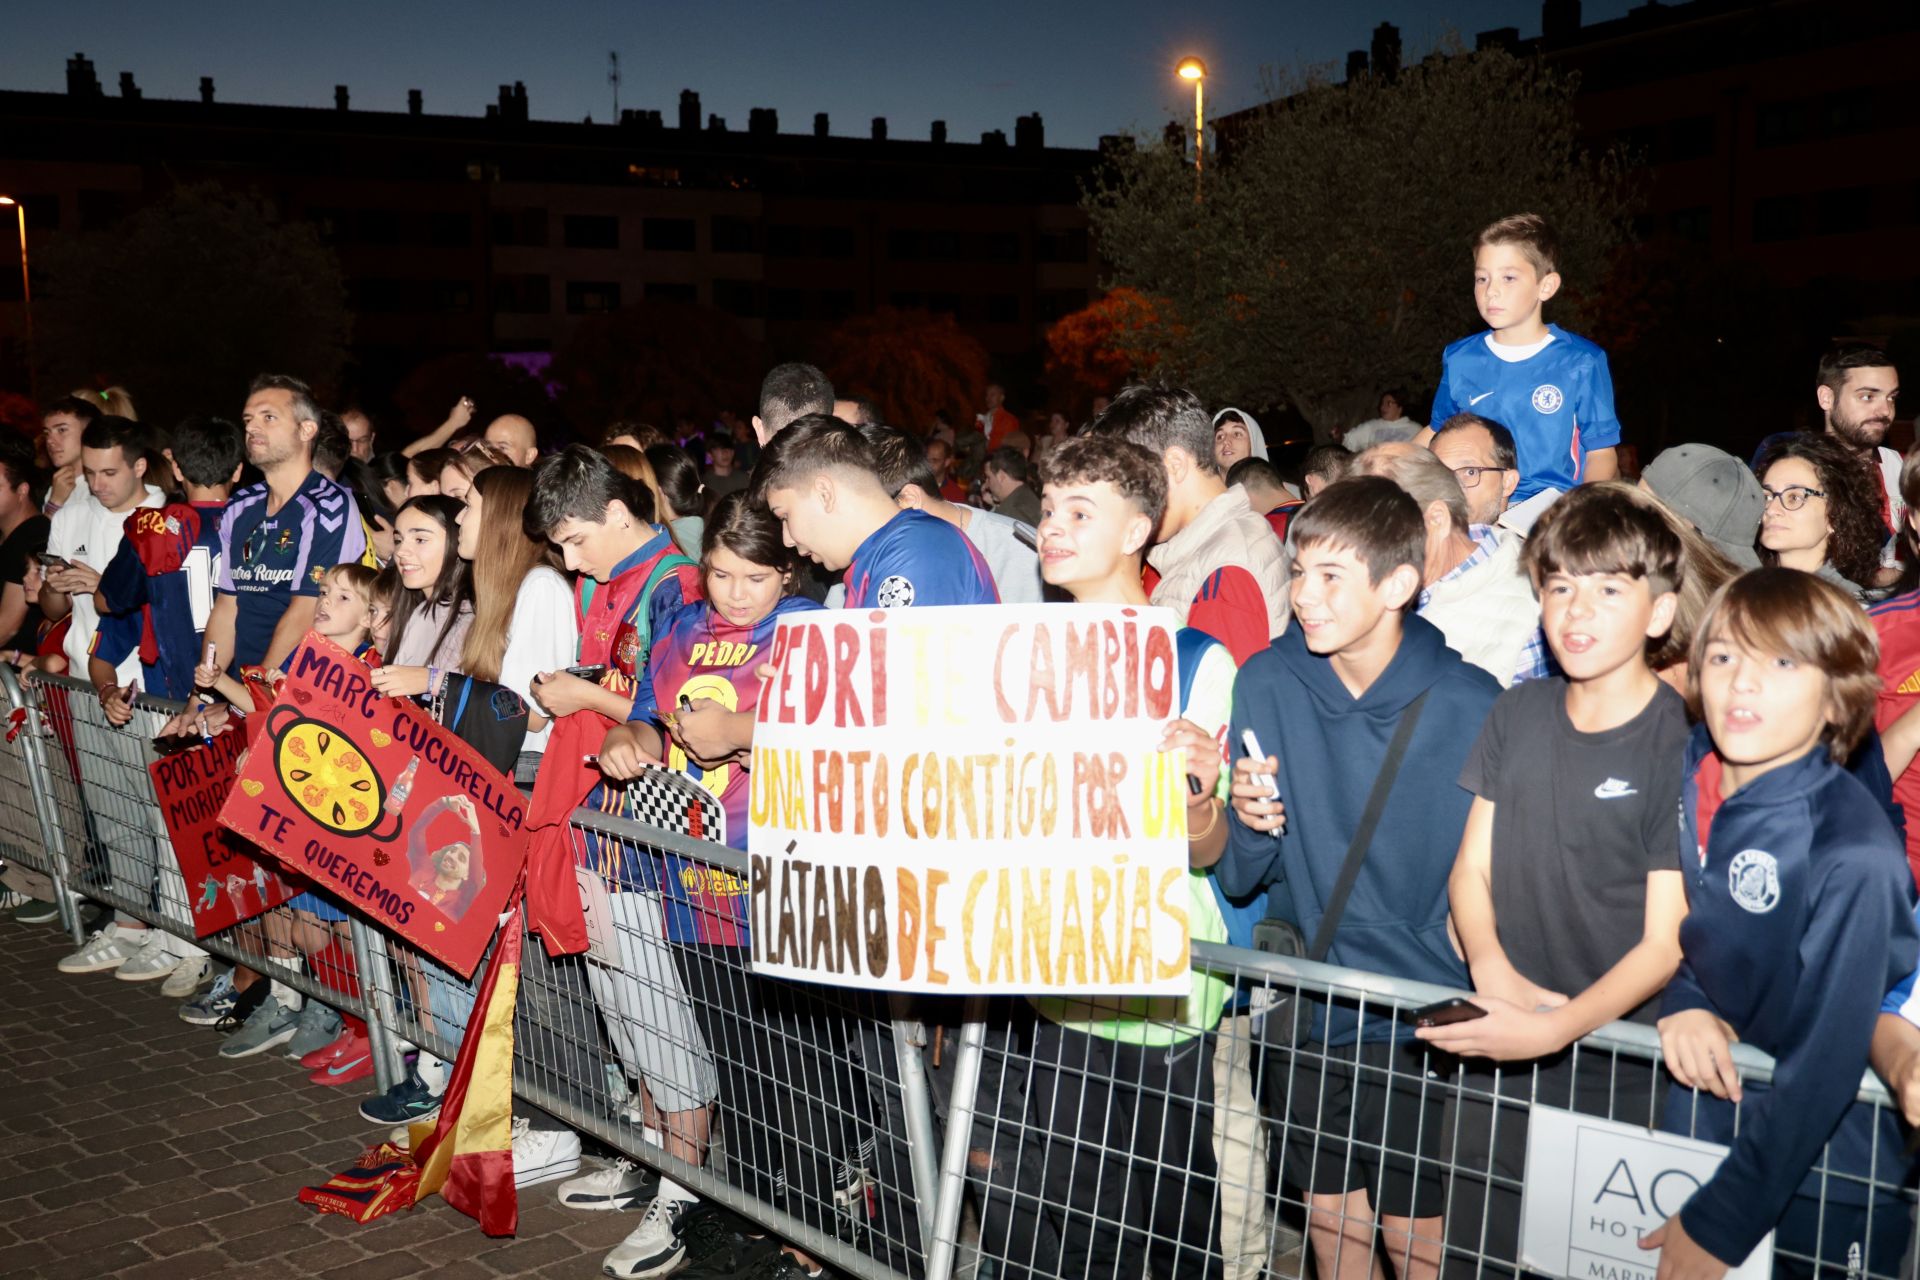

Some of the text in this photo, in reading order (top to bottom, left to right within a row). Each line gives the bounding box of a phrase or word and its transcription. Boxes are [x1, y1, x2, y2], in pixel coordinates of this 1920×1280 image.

[687, 640, 758, 667] PEDRI
[901, 622, 974, 727] TE
[157, 754, 200, 796] POR
[200, 744, 225, 778] LA
[296, 645, 524, 831] MARC CUCURELLA
[750, 745, 808, 831] UNA
[813, 750, 889, 838] FOTO
[1072, 750, 1132, 840] POR
[1142, 751, 1187, 839] UN
[257, 803, 416, 925] TE QUEREMOS
[751, 839, 890, 979] PLÁTANO
[897, 866, 950, 985] DE
[1590, 1215, 1646, 1239] HOT
